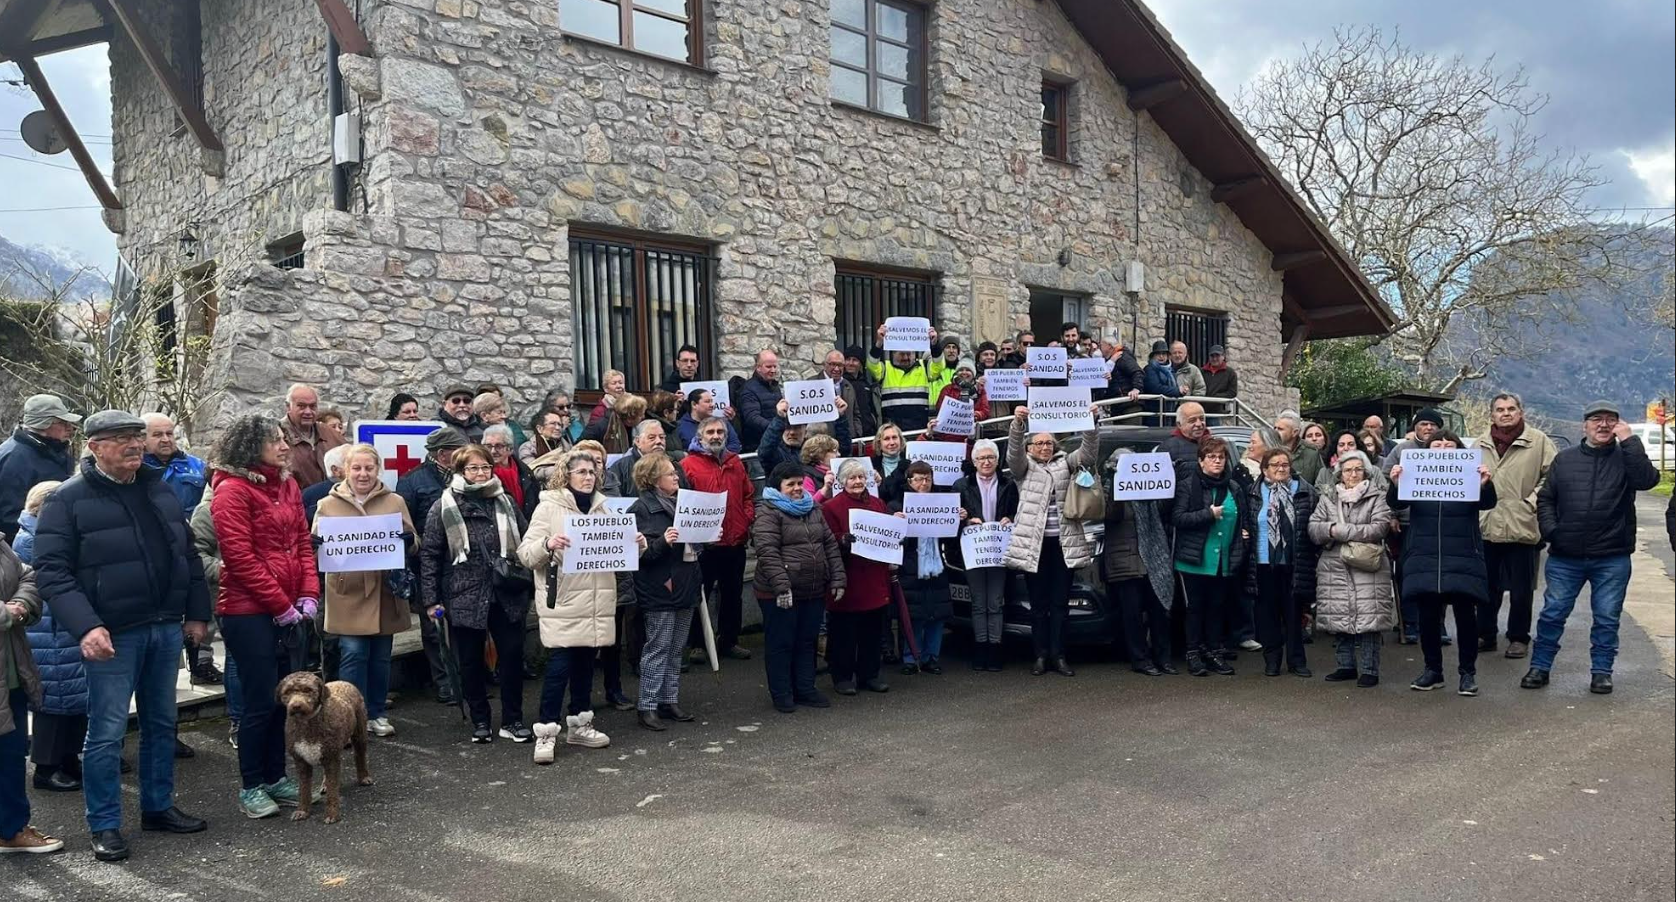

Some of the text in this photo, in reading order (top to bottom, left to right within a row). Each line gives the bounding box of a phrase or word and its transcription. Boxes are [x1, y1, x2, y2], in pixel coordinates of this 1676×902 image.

[800, 388, 824, 399] S.O.S
[947, 400, 960, 408] LOS
[1032, 401, 1077, 409] ¡SALVEMOS
[790, 404, 833, 416] SANIDAD
[920, 454, 954, 462] SANIDAD
[1131, 462, 1160, 473] S.O.S
[1416, 464, 1462, 472] TAMBIÉN
[1118, 480, 1171, 491] SANIDAD
[1415, 478, 1464, 486] TENEMOS
[692, 508, 720, 516] SANIDAD
[572, 517, 633, 526] LOS PUEBLOS
[963, 526, 978, 535] LOS
[322, 530, 400, 543] LA SANIDAD ES
[582, 530, 624, 541] TAMBIÉN
[894, 531, 901, 540] EL
[326, 544, 396, 556] UN DERECHO
[580, 546, 624, 556] TENEMOS
[576, 560, 626, 570] DERECHOS
